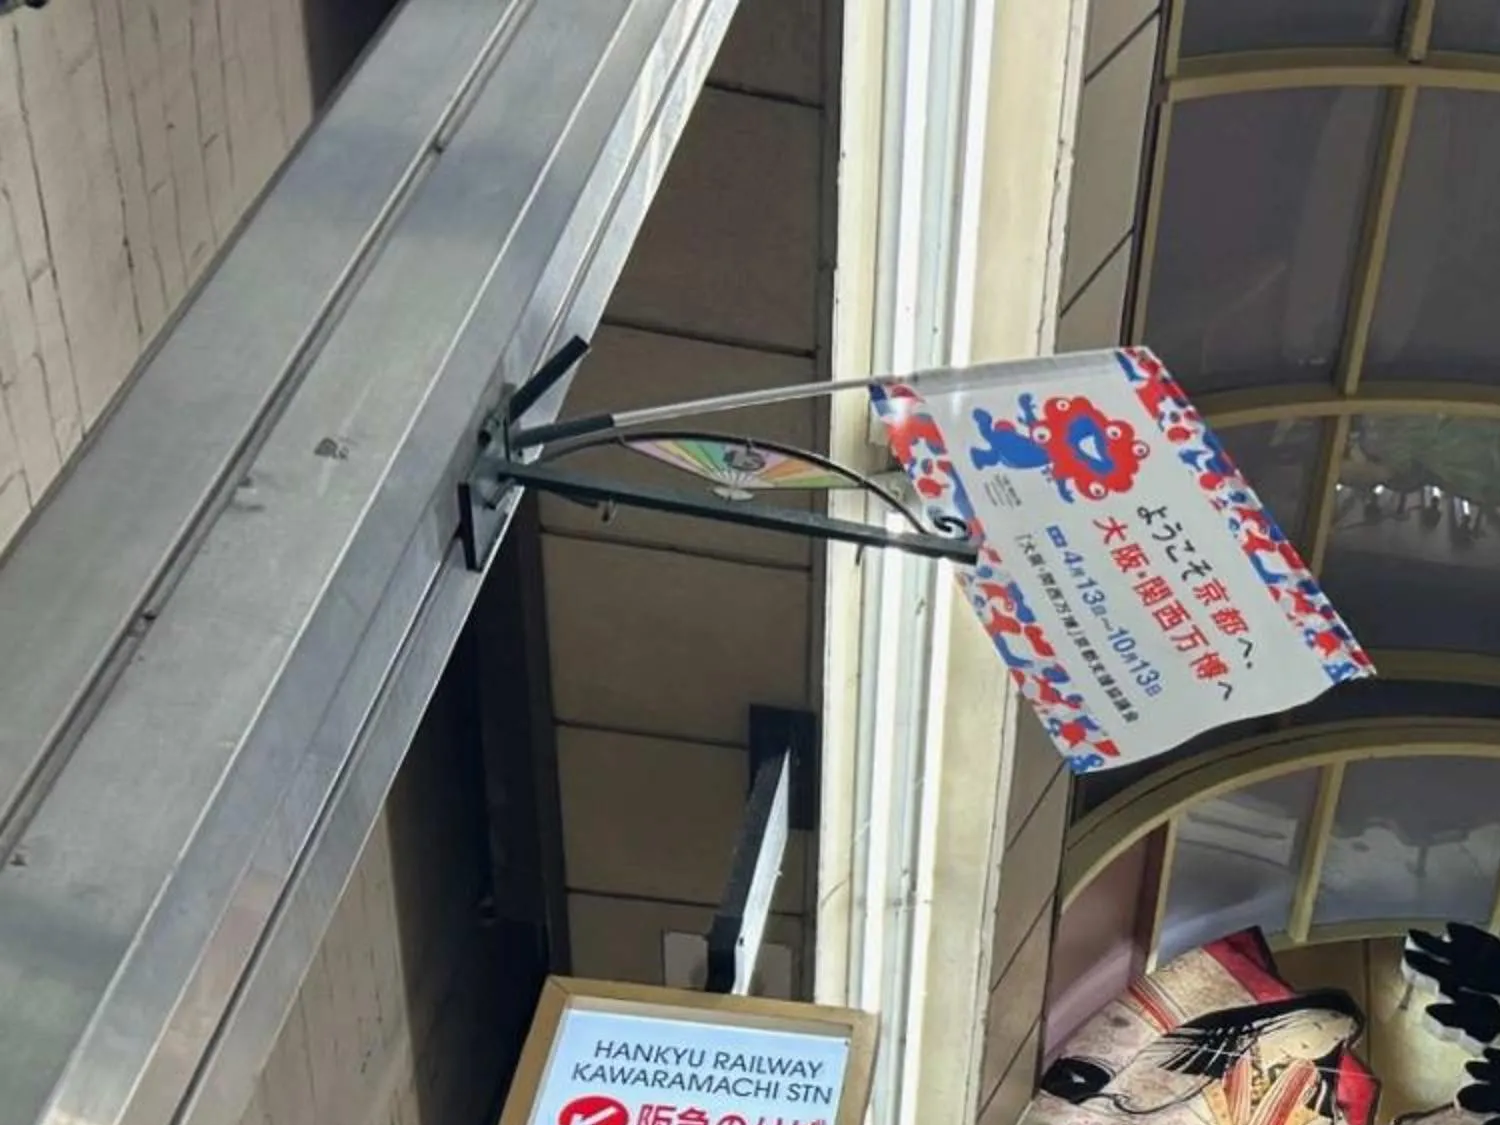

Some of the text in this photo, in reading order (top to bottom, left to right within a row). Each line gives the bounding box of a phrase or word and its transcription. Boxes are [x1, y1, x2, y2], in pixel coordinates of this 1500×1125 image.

[1092, 514, 1234, 702] 大阪・関西万博へ
[593, 1039, 824, 1080] HANKYU RAILWAY
[571, 1062, 834, 1105] KAWARAMACHI STN
